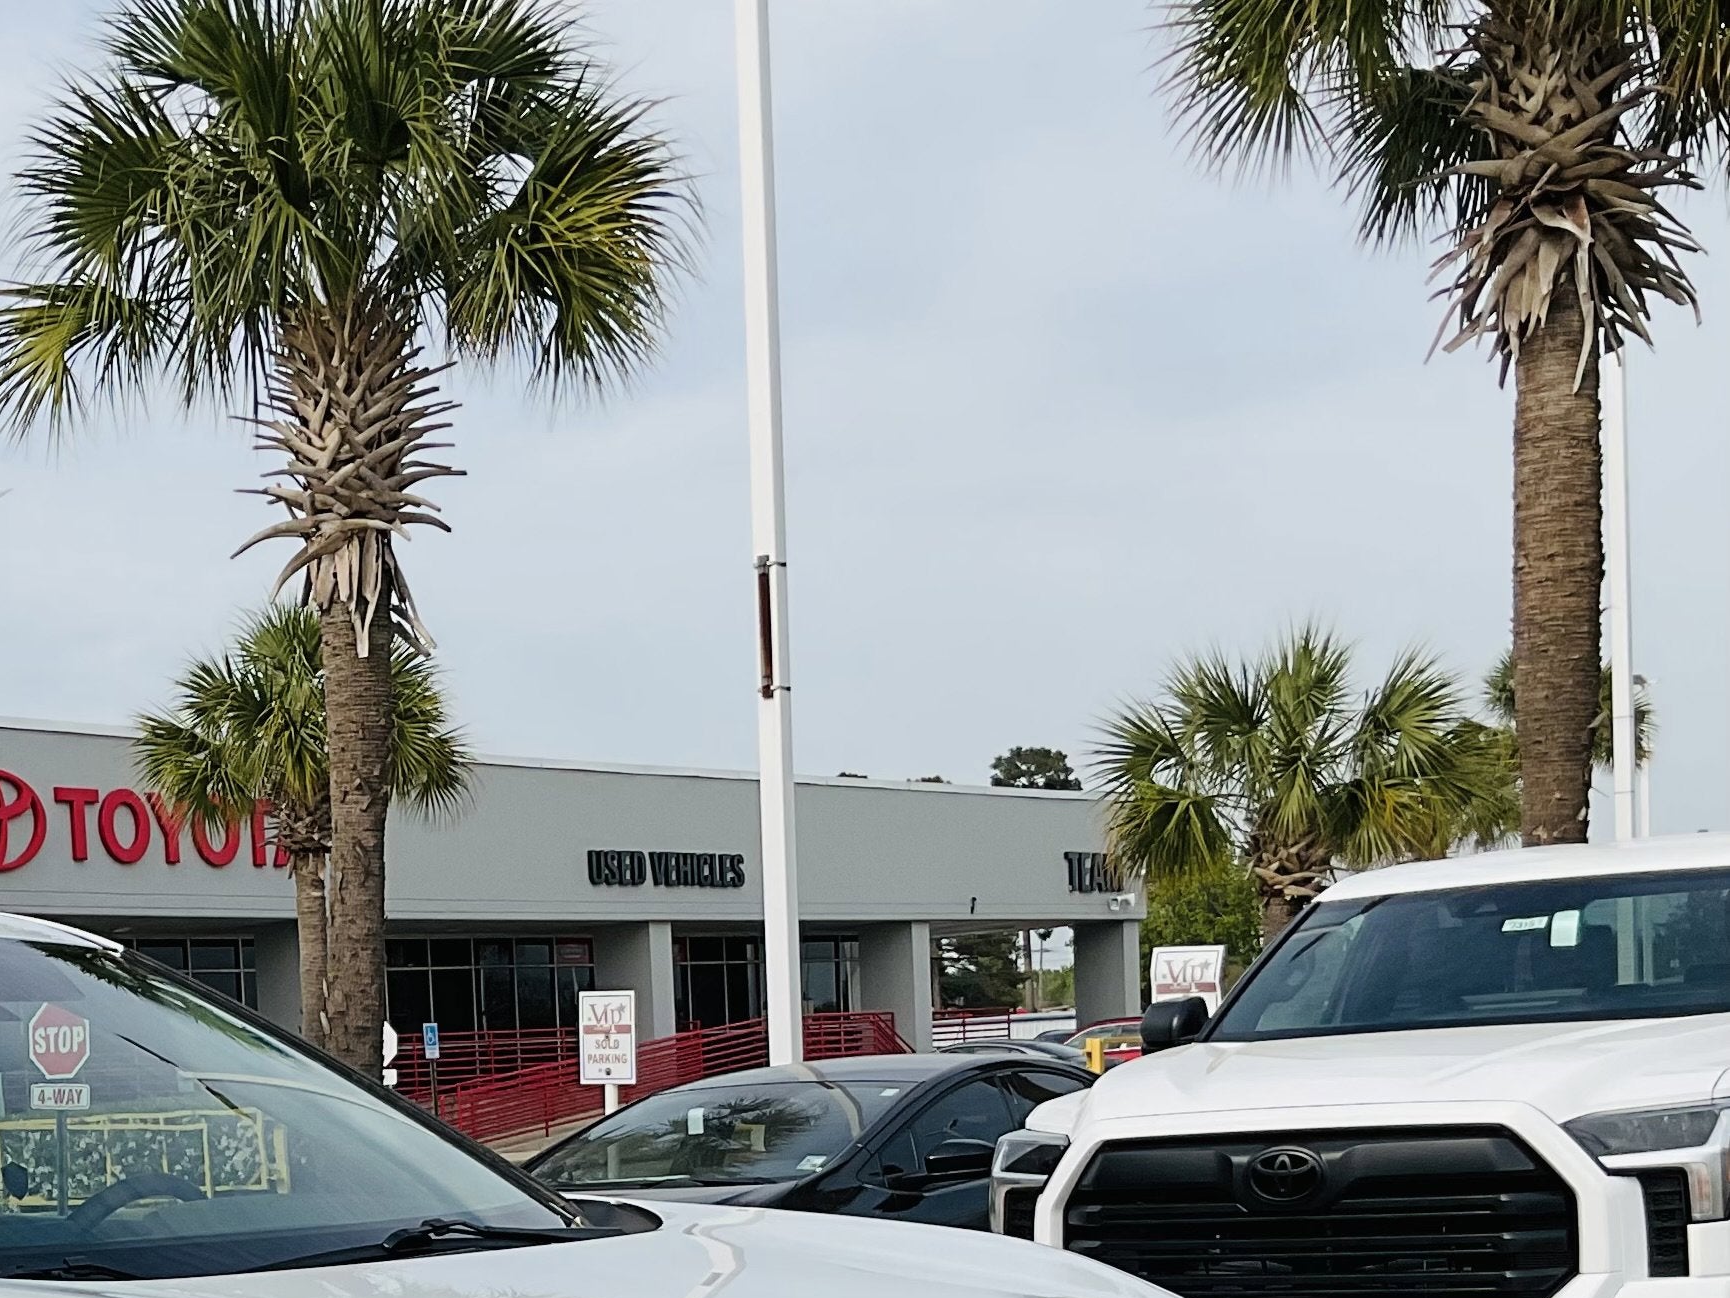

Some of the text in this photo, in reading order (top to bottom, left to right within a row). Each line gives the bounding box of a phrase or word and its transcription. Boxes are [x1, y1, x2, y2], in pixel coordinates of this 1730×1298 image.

[53, 786, 292, 868] TOYOT
[587, 850, 745, 888] USED VEHICLES
[34, 1025, 85, 1054] STOP
[594, 1038, 620, 1050] SOLD
[587, 1053, 628, 1065] PARKING
[37, 1087, 83, 1106] 4-WAY
